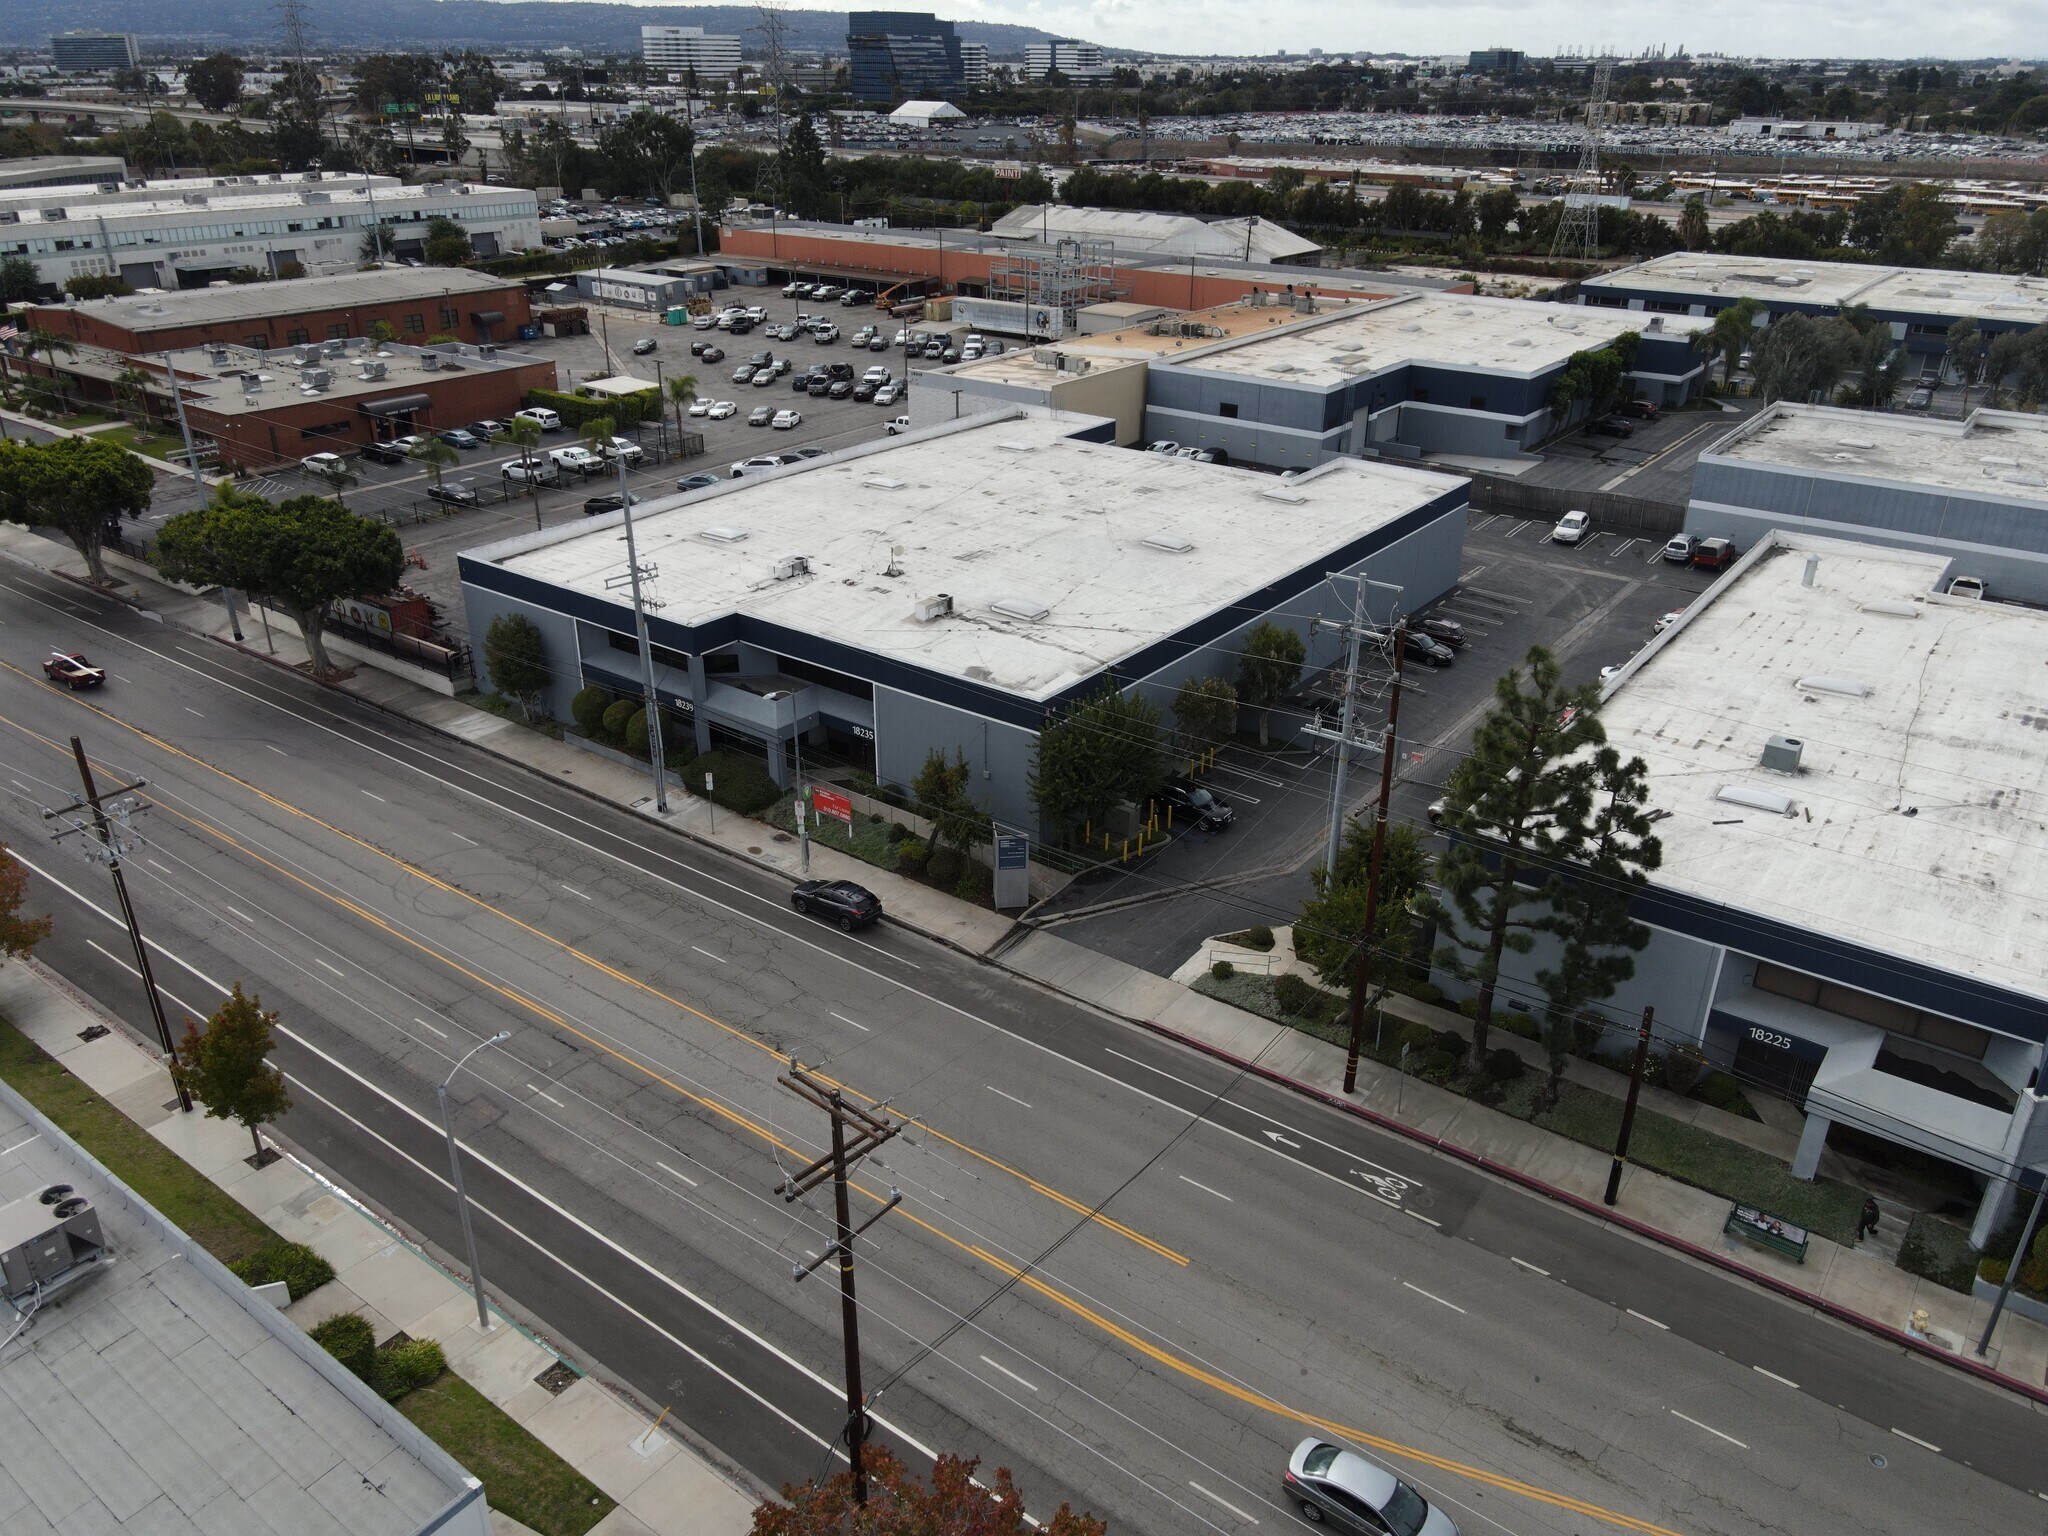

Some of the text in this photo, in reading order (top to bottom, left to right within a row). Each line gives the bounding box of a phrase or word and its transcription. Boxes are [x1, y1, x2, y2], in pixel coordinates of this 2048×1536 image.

[995, 168, 1019, 178] PAINT
[674, 698, 694, 711] 18239
[852, 725, 874, 740] 18235
[1750, 1027, 1792, 1049] 18225
